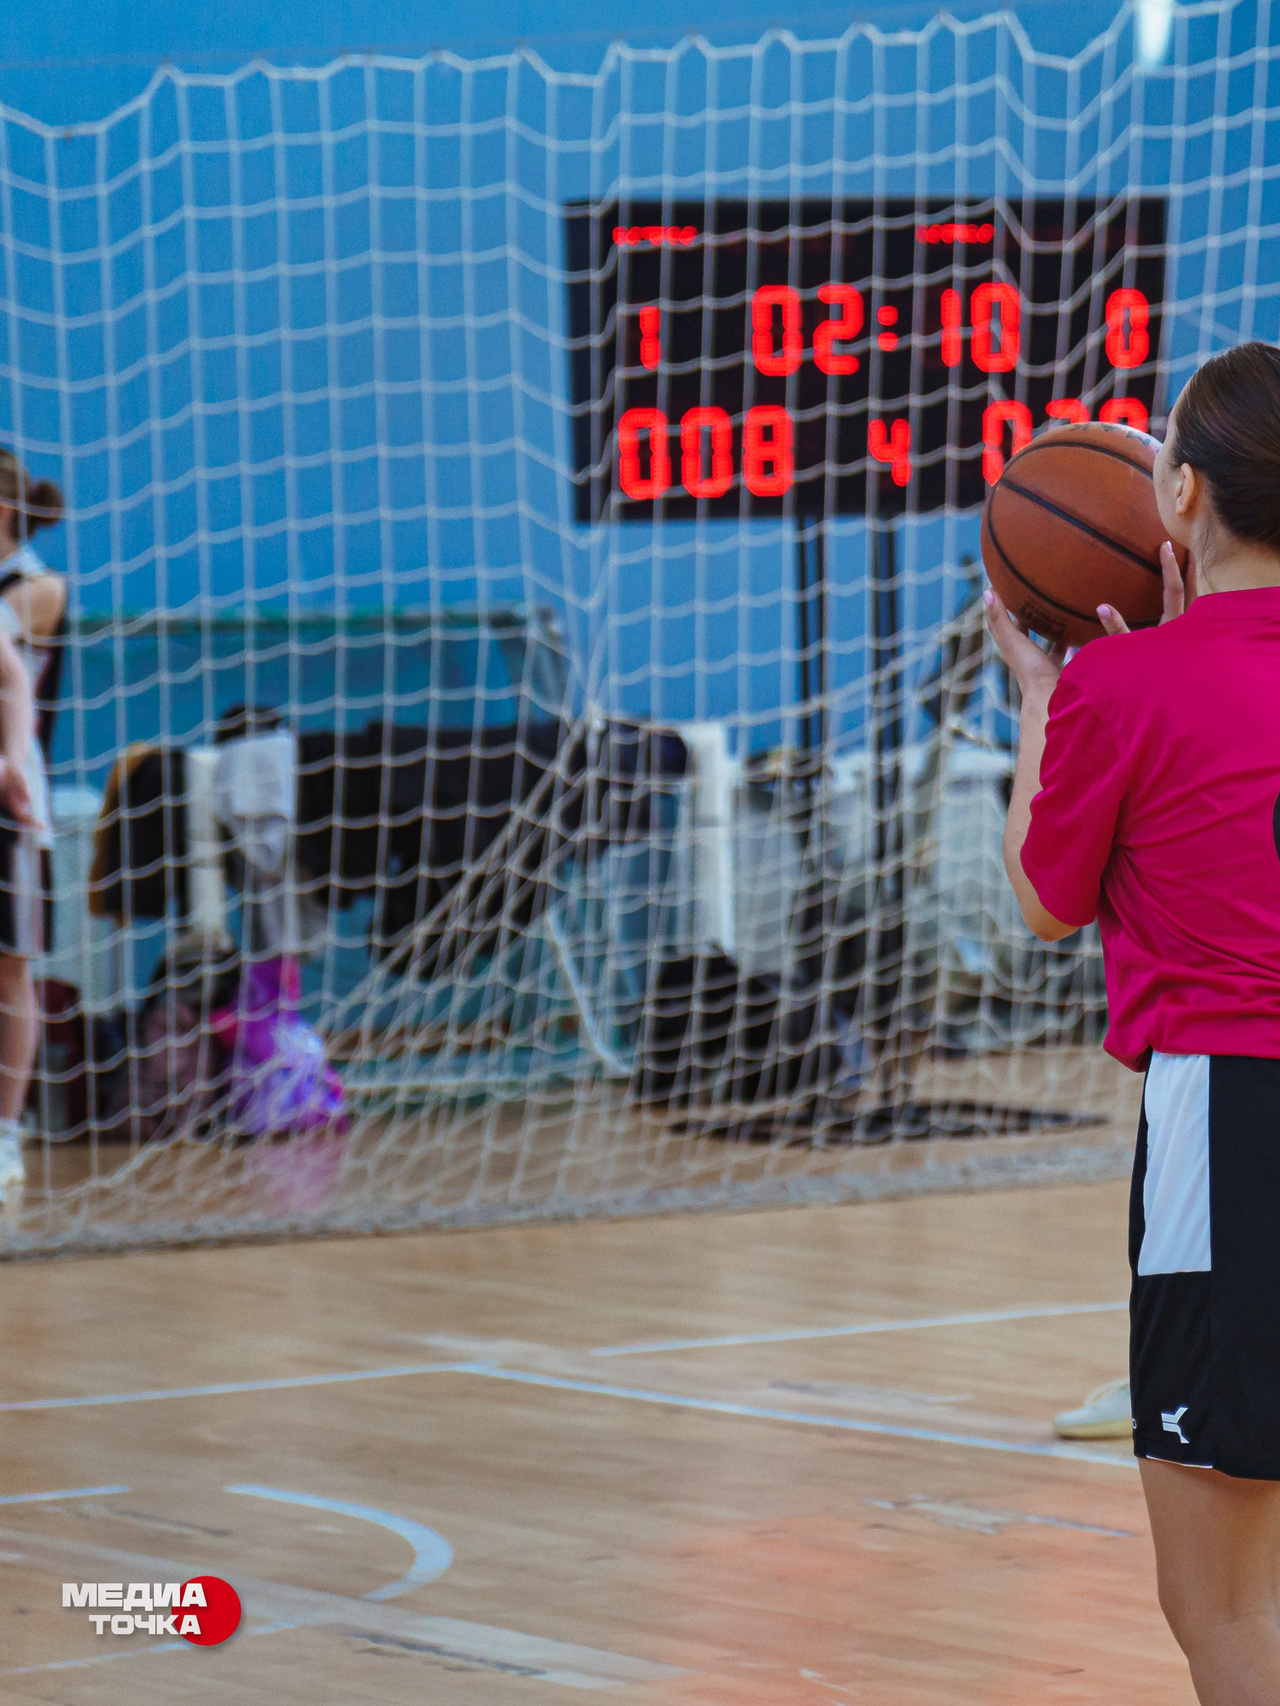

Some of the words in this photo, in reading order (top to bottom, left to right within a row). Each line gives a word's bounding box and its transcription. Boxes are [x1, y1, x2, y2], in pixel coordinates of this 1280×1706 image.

[640, 306, 660, 370] 1
[751, 282, 1020, 376] 02:10
[1105, 288, 1149, 369] 0
[618, 405, 794, 500] 008
[868, 419, 912, 487] 4
